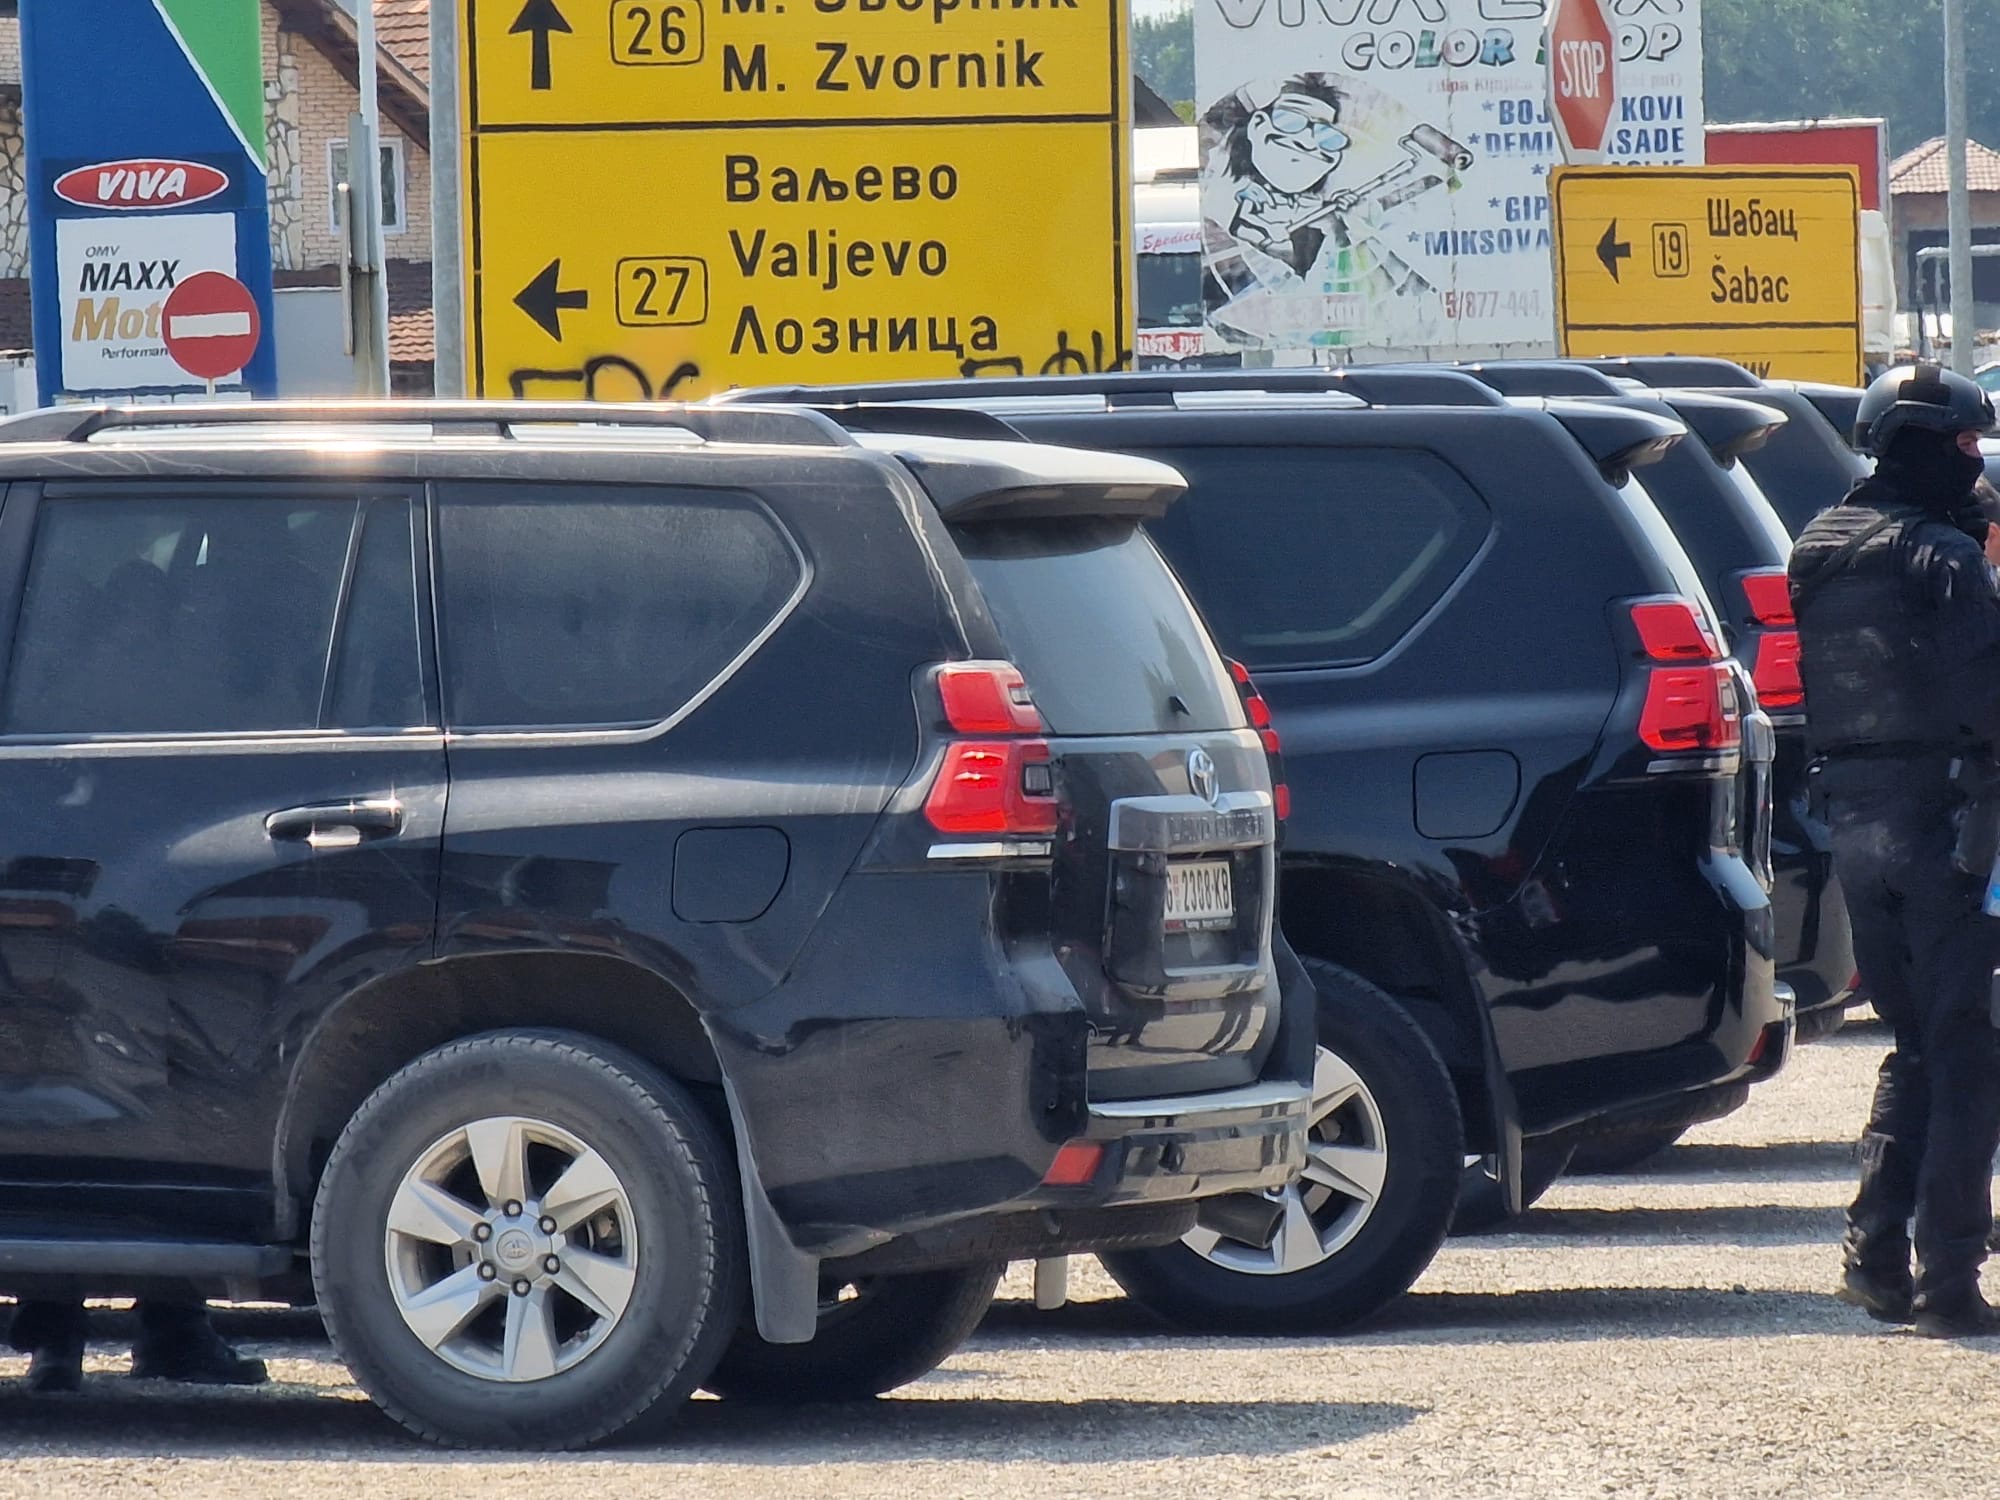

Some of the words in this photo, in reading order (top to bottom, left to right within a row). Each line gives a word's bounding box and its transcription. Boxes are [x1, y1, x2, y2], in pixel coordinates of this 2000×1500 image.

[626, 6, 686, 55] 26
[1341, 27, 1515, 71] COLOR
[723, 44, 786, 92] M.
[815, 38, 1045, 91] Zvornik
[1560, 40, 1606, 98] STOP
[1499, 98, 1549, 126] BOJ
[1621, 95, 1684, 122] KOVI
[98, 168, 187, 200] VIVA
[724, 155, 958, 203] Ваљево
[1424, 228, 1549, 256] MIKSOVA
[1707, 198, 1798, 242] Шабац
[85, 245, 120, 258] OMV
[728, 229, 948, 290] Valjevo
[1658, 230, 1682, 270] 19
[79, 260, 181, 292] MAXX
[631, 266, 691, 317] 27
[1710, 254, 1790, 304] Šabac
[72, 297, 162, 342] Mot
[729, 305, 999, 359] Лозница
[101, 347, 169, 360] Performan
